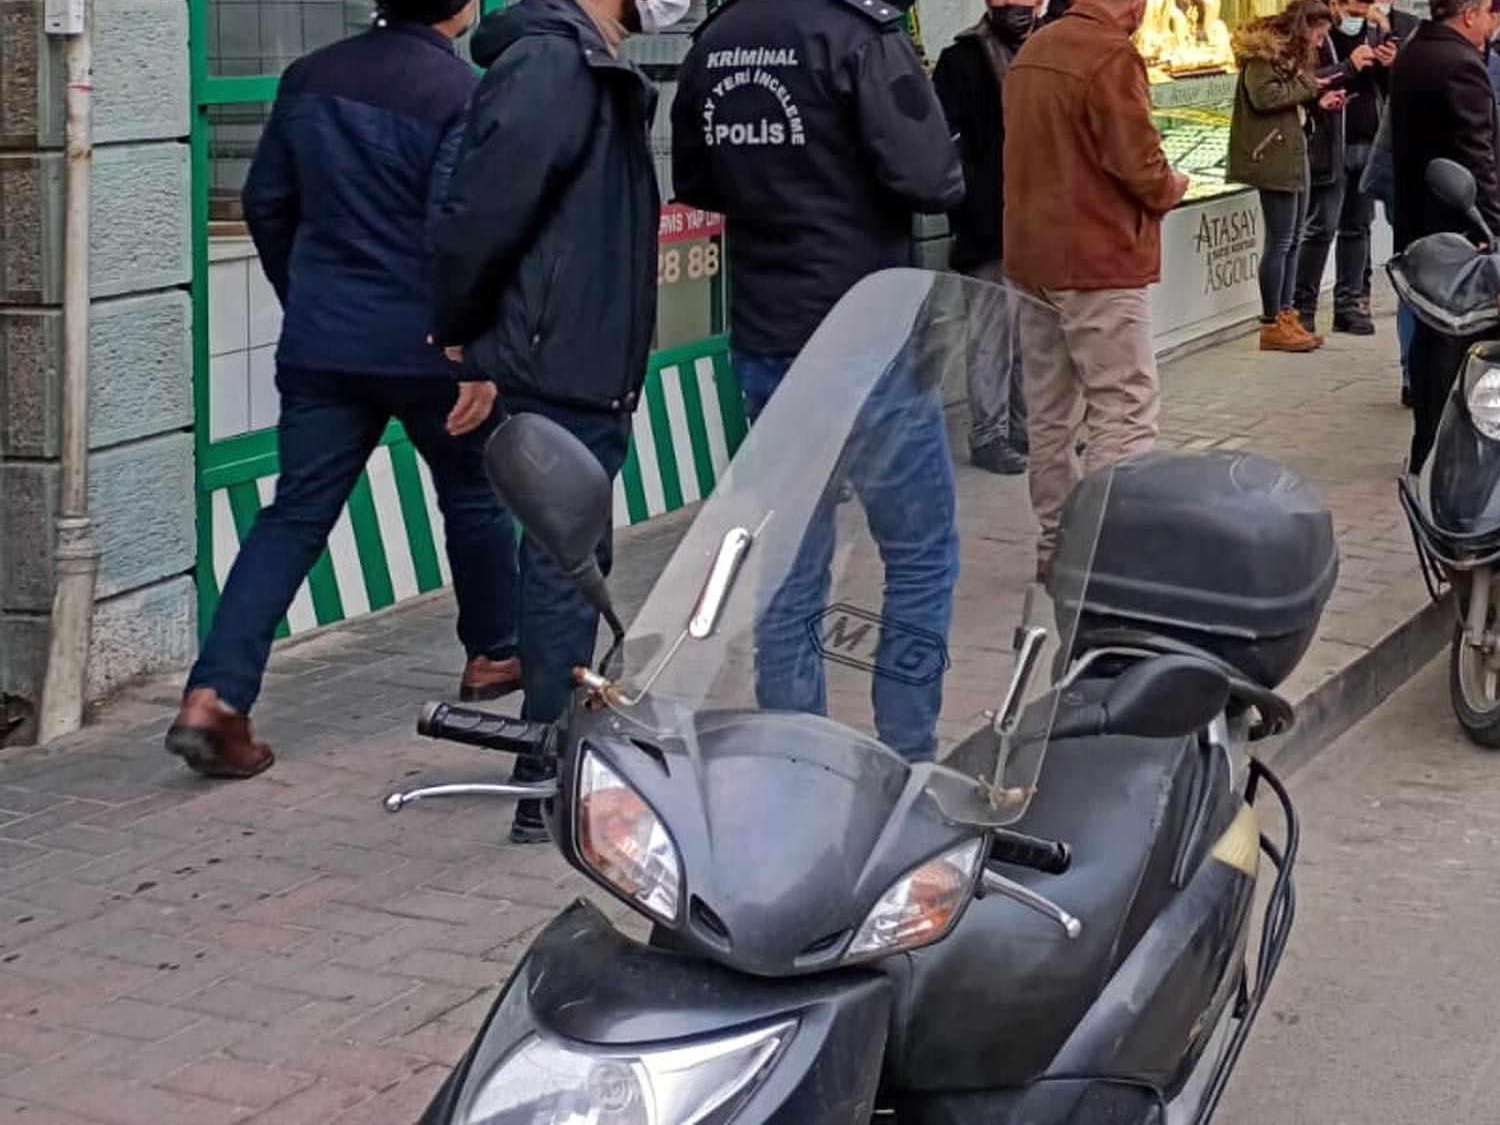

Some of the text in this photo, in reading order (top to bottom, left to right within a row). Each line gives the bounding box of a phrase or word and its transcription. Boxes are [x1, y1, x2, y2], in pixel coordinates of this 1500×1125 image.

[707, 46, 798, 68] KRİMİNAL
[715, 118, 785, 145] POLİS
[687, 243, 719, 279] 88
